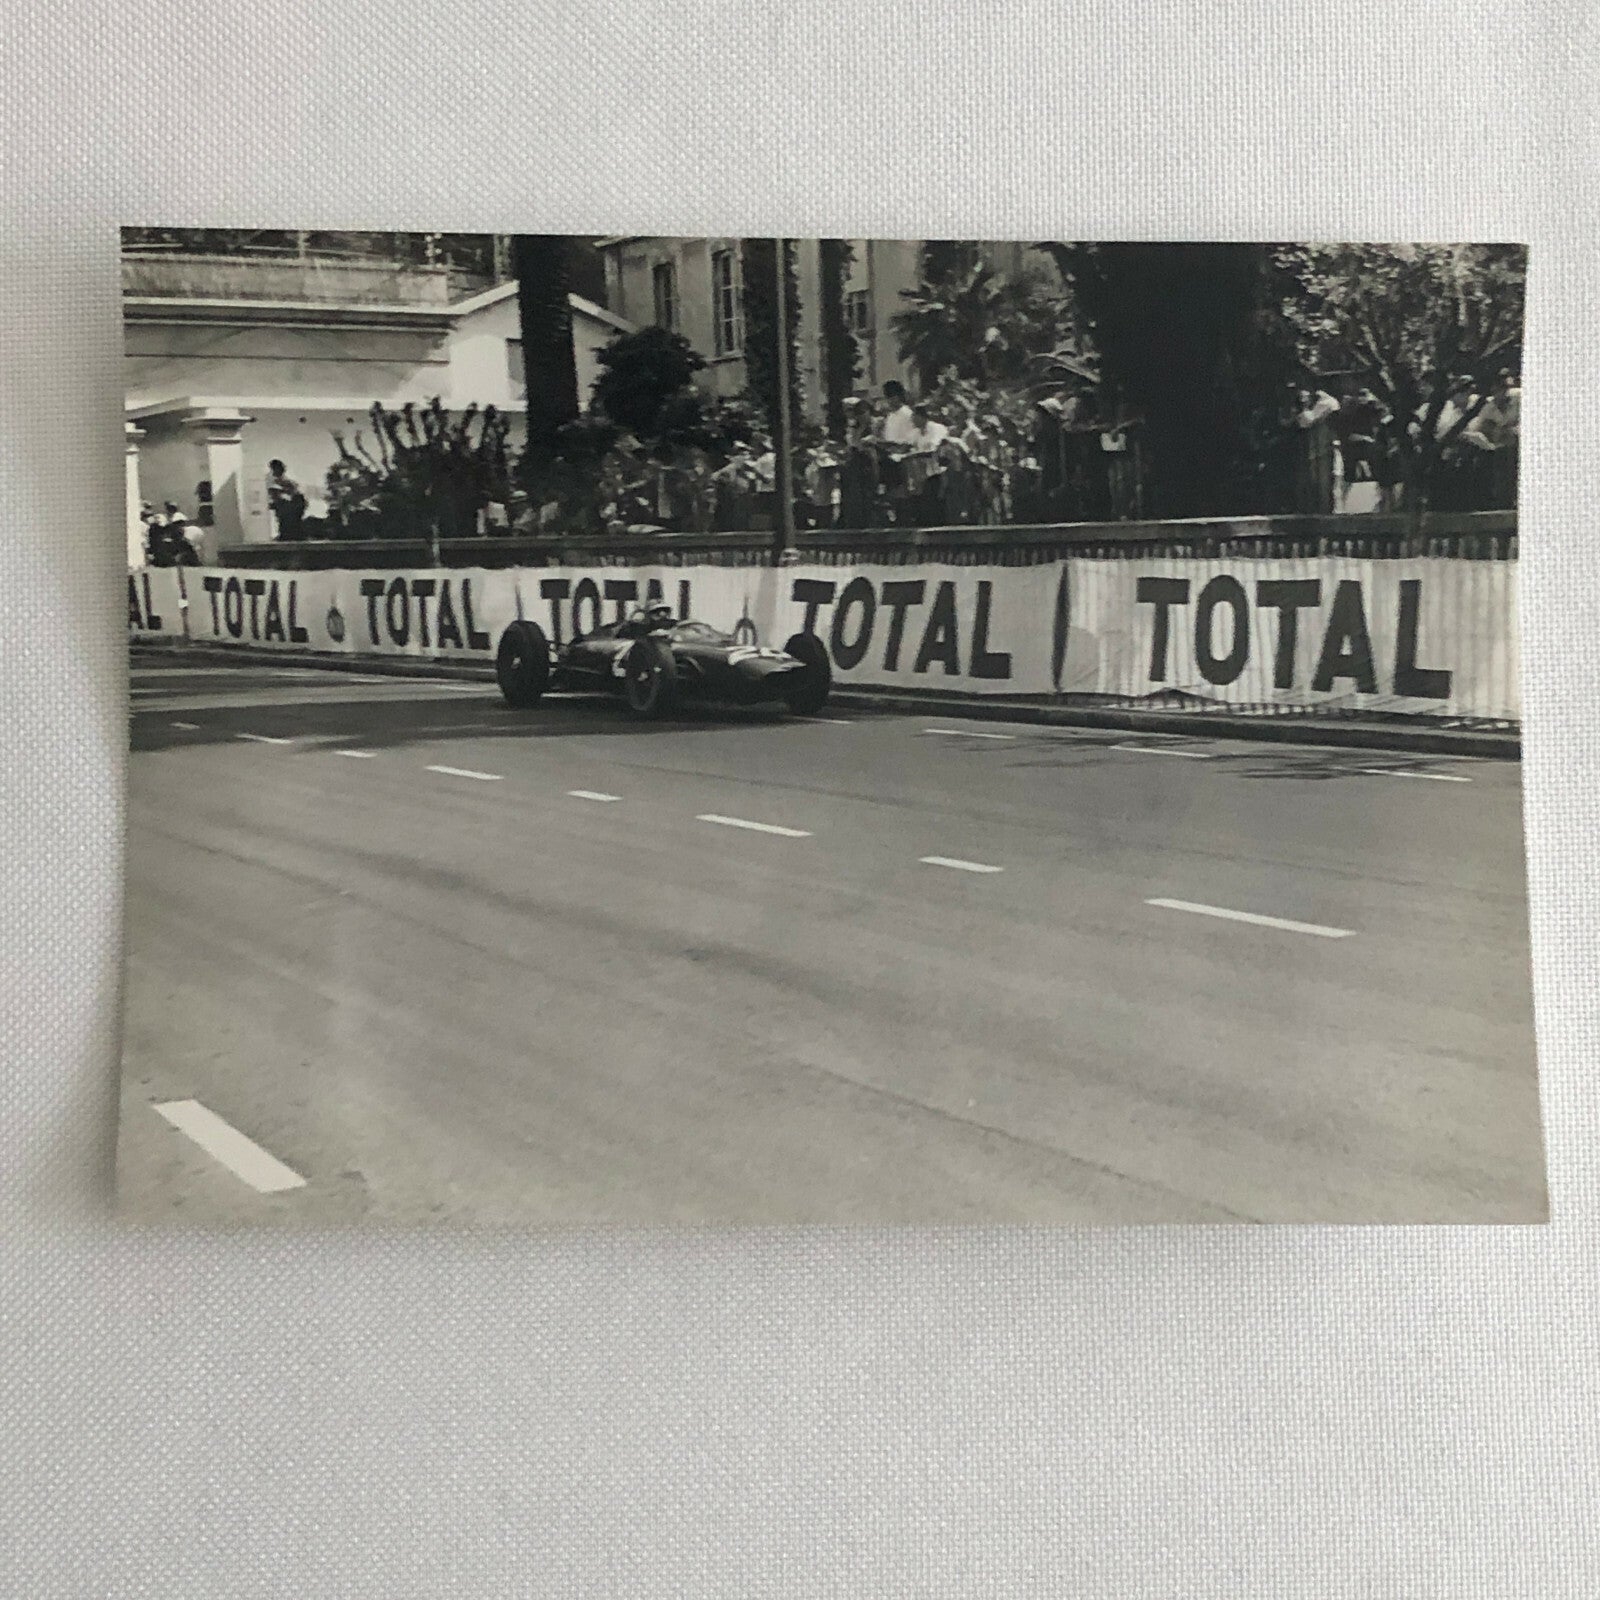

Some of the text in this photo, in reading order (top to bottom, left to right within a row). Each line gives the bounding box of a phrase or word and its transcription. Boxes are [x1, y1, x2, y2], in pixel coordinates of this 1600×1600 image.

[203, 576, 308, 642] TOTAL
[361, 576, 490, 650] TOTAL
[792, 576, 1011, 679] TOTAL
[1136, 574, 1452, 699] TOTAL
